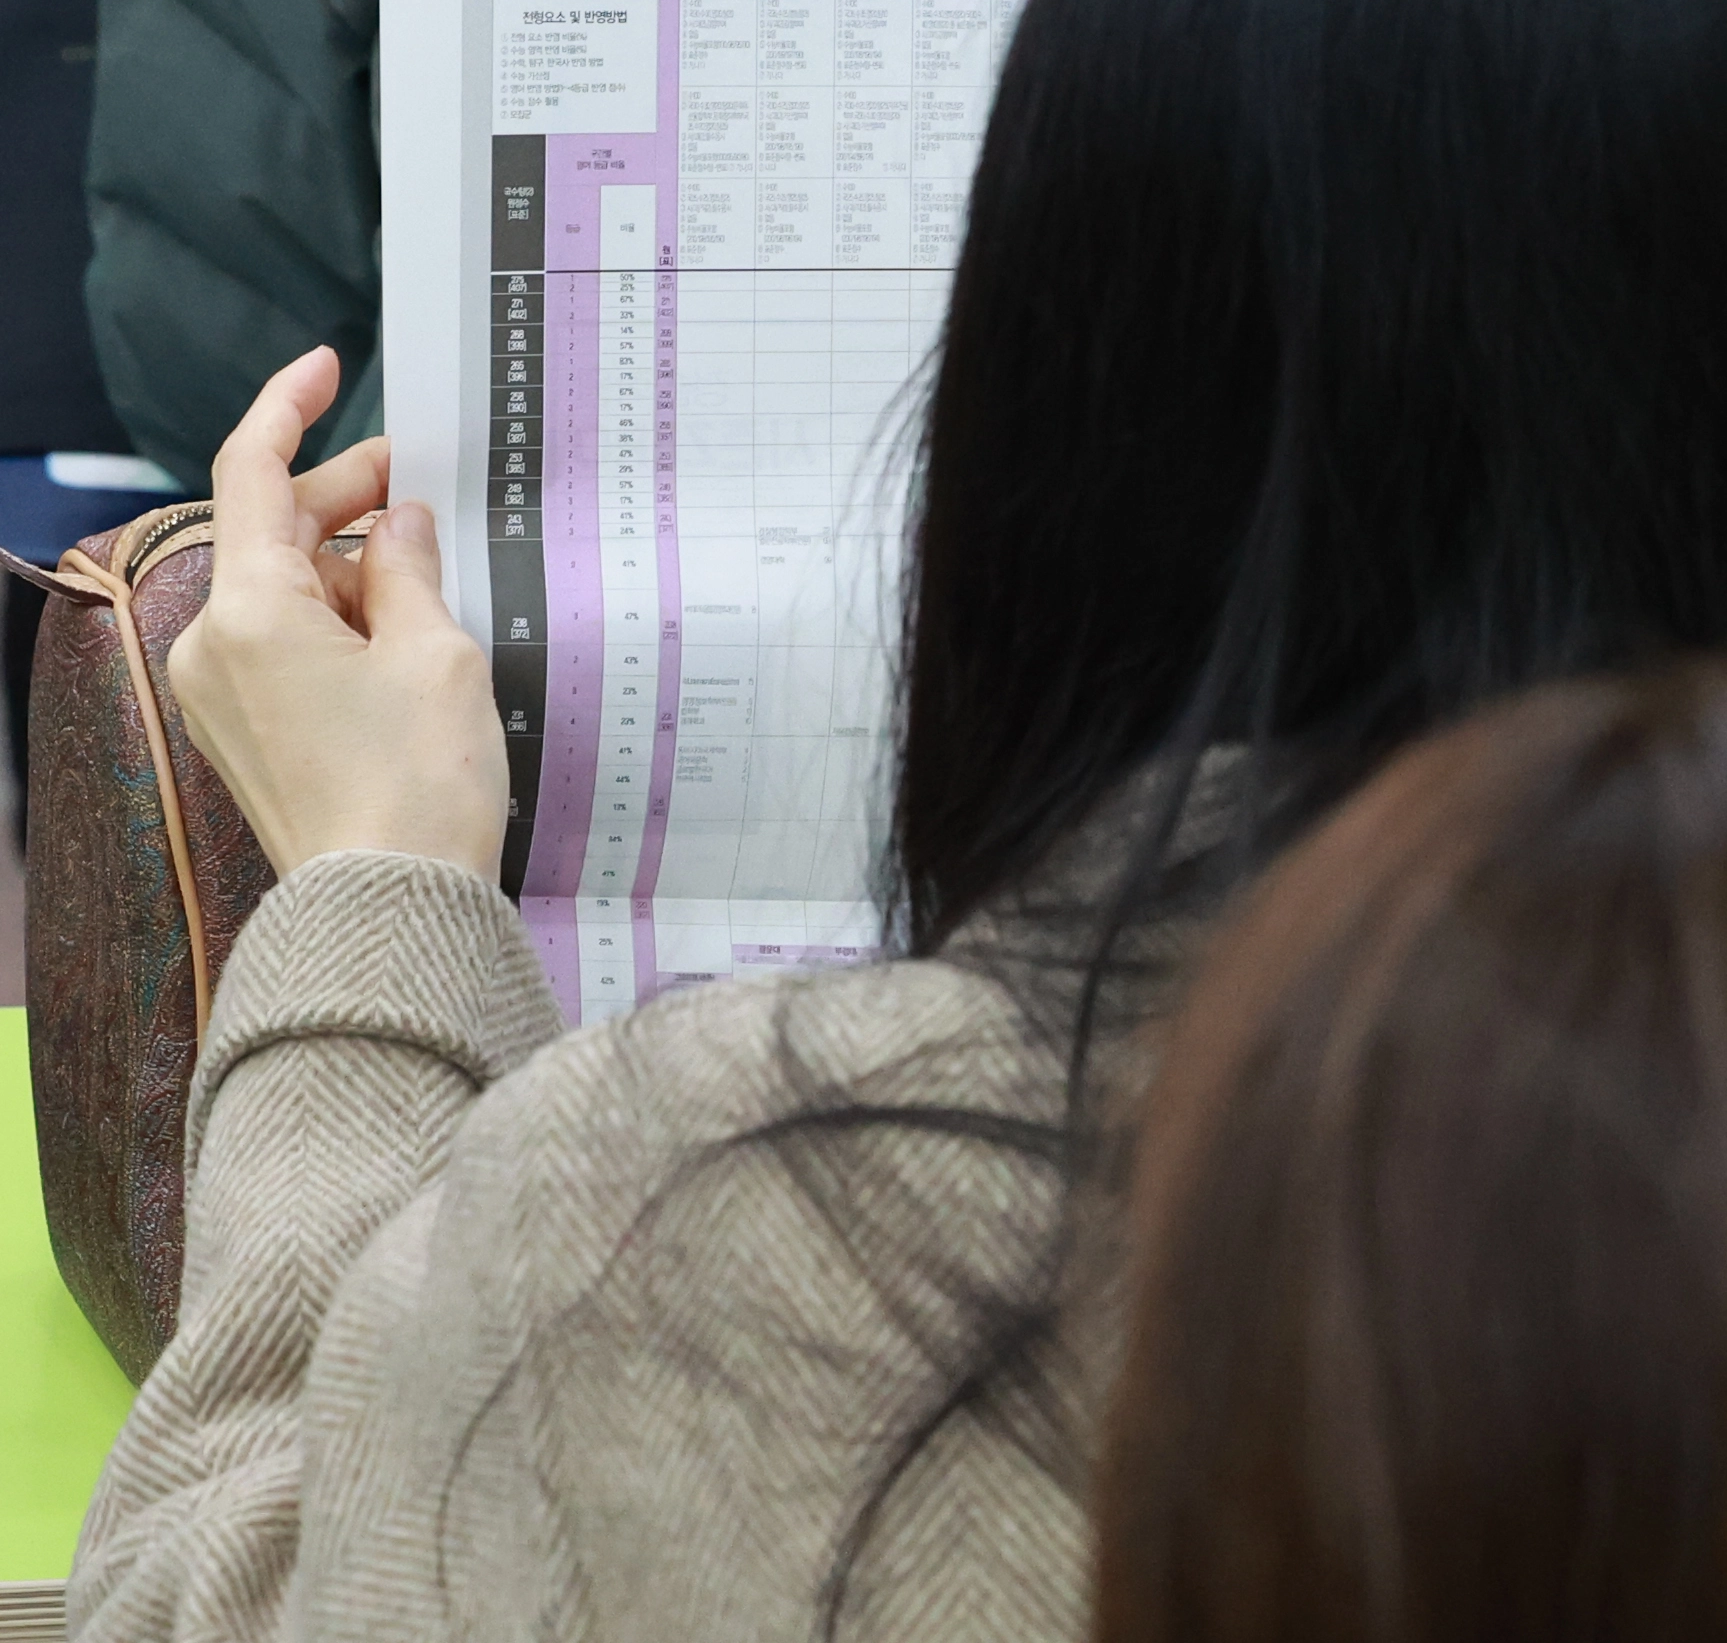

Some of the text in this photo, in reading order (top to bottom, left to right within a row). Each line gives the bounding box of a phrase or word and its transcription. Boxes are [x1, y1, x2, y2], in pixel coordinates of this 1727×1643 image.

[522, 10, 628, 25] 전형요소 및 반영방법
